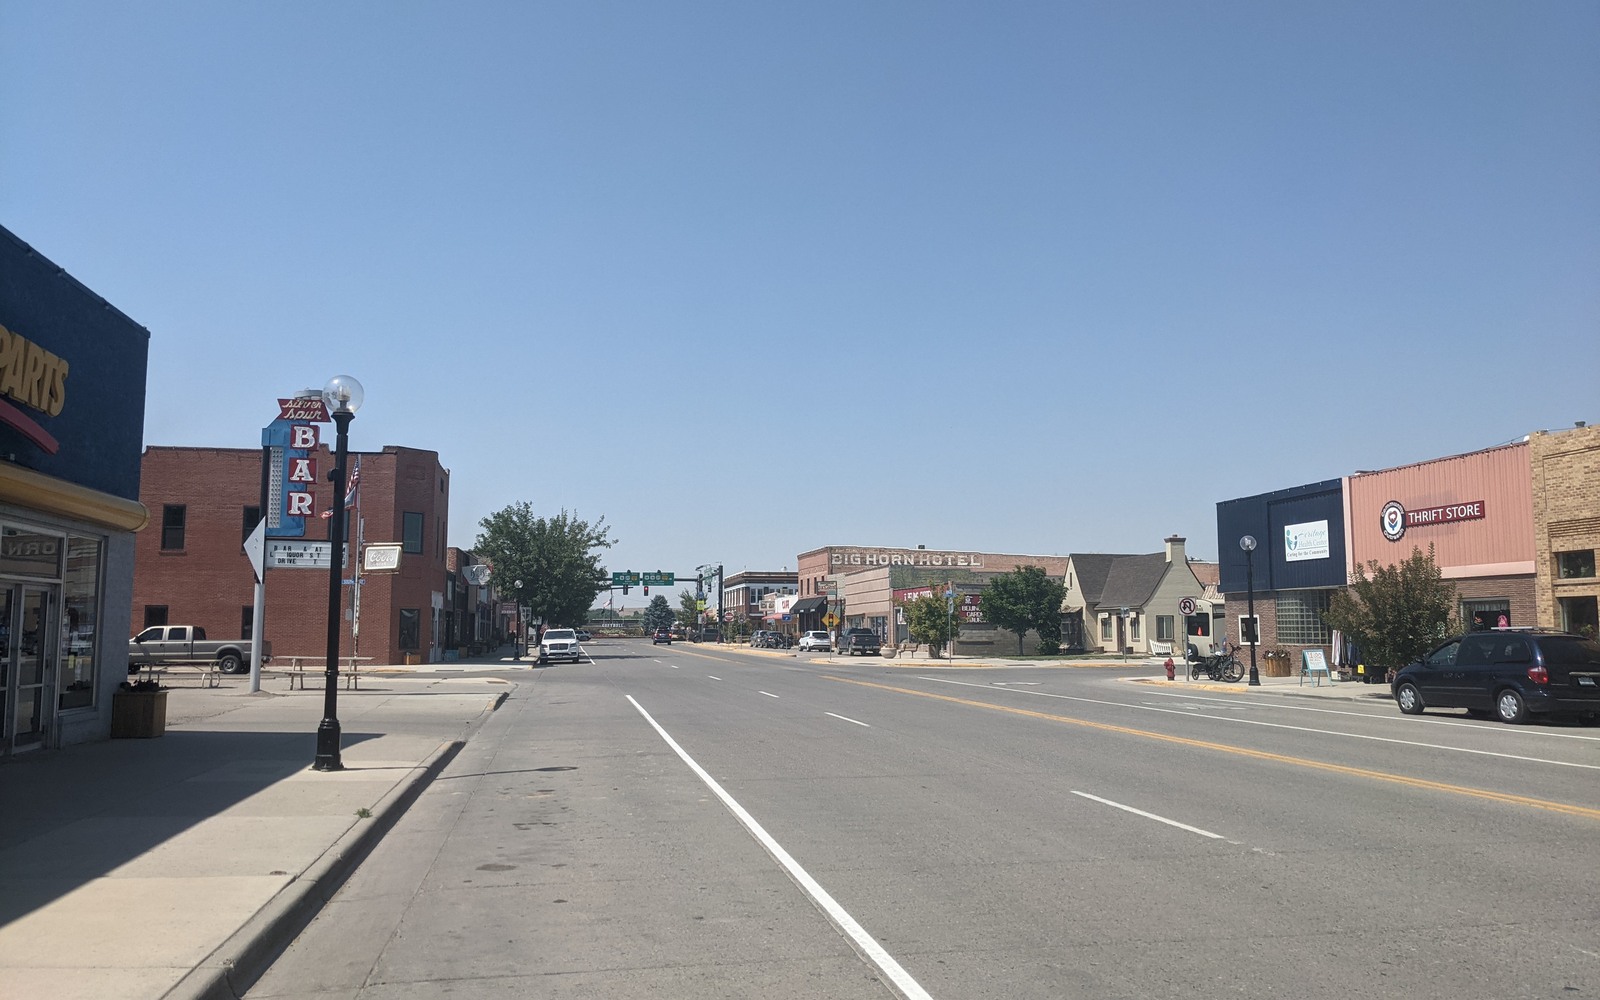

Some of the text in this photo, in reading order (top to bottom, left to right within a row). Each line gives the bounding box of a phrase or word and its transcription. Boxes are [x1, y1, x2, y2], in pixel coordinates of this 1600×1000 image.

[288, 425, 316, 515] BAR
[1408, 503, 1481, 524] THRIFT STORE
[831, 553, 981, 566] BIG HORN HOTEL
